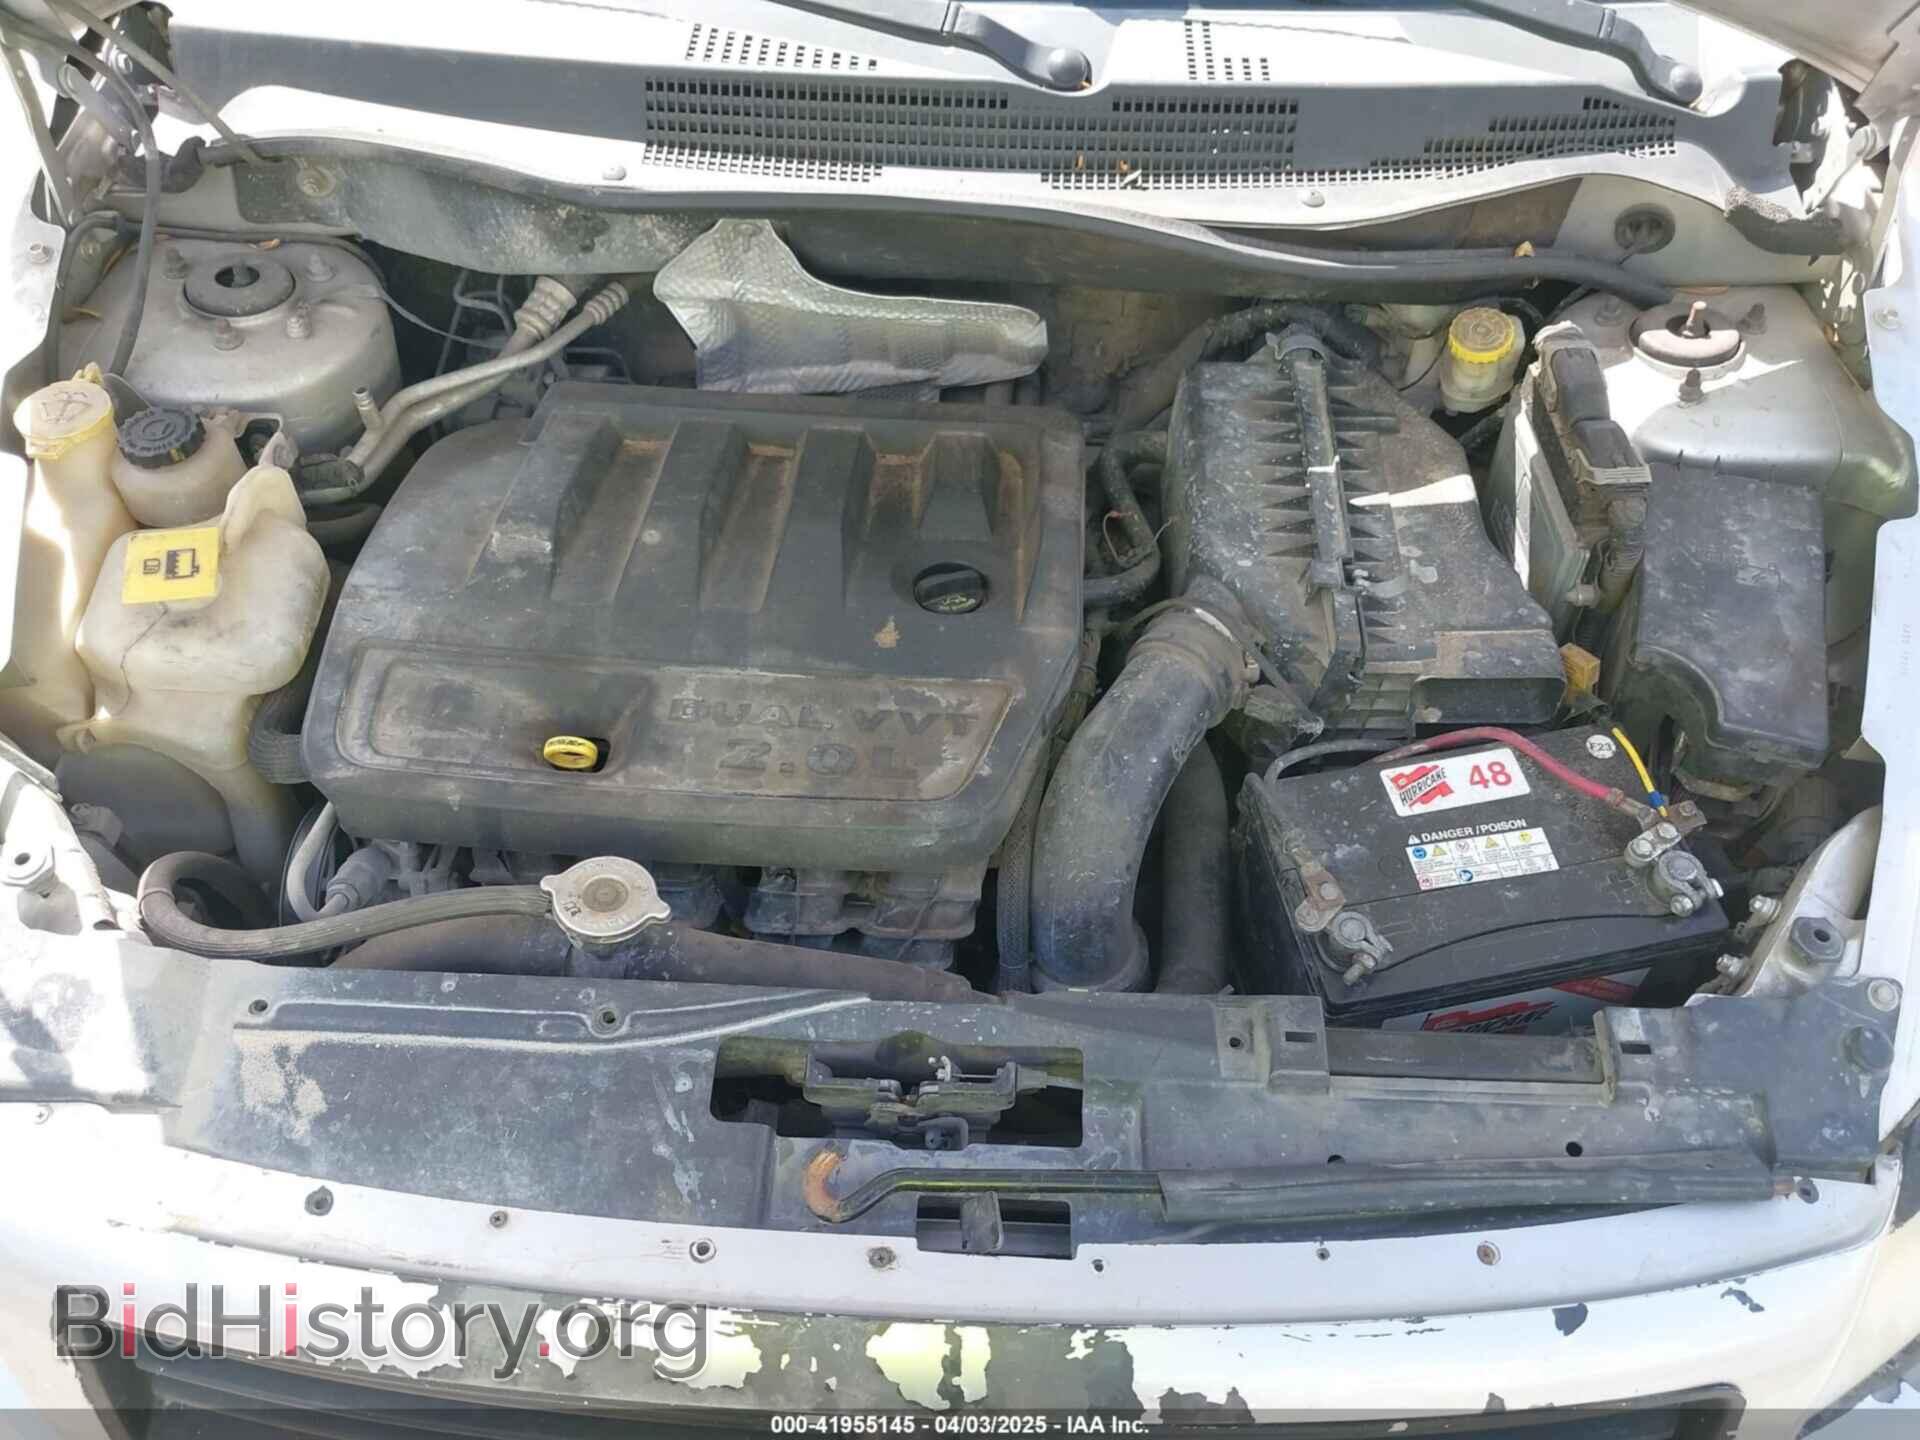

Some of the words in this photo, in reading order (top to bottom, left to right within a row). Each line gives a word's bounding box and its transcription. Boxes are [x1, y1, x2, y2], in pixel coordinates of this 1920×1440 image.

[668, 698, 833, 729] DUAL
[855, 708, 980, 737] VVT
[717, 737, 921, 779] 2.0L
[1400, 767, 1447, 806] HURRICANE
[1469, 761, 1512, 788] 48
[1420, 826, 1475, 842] DANGER
[1480, 818, 1527, 834] POISON
